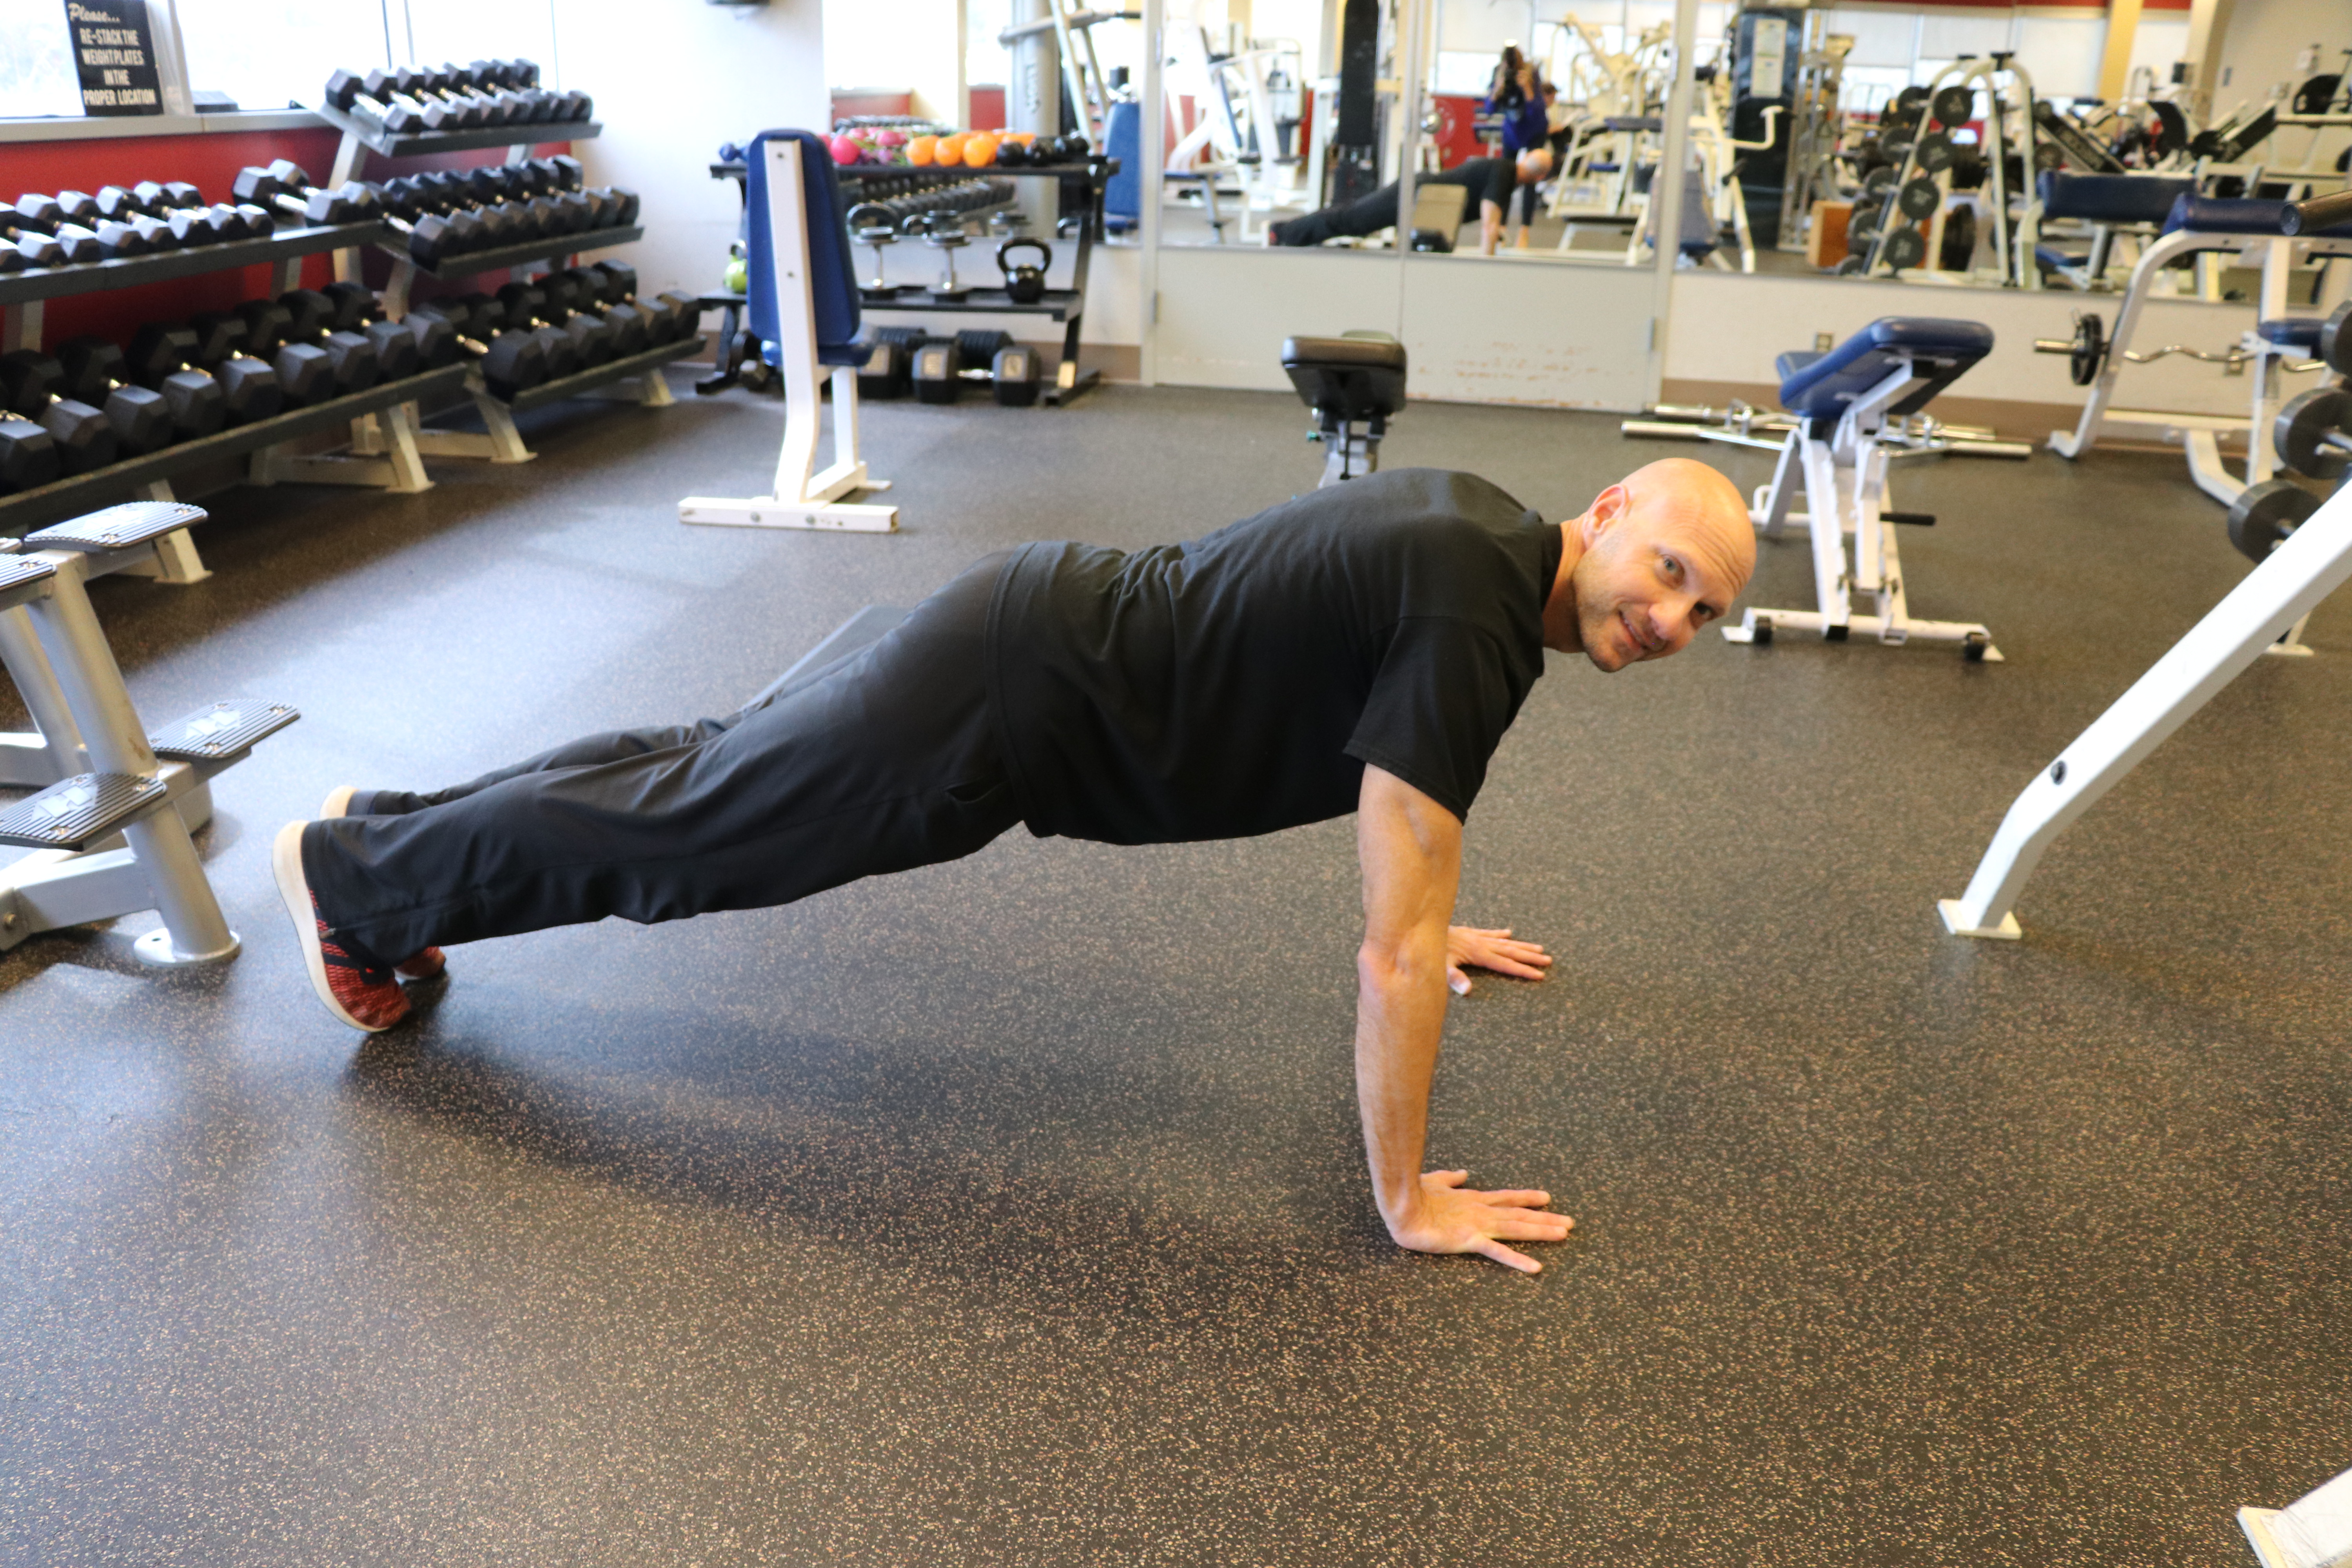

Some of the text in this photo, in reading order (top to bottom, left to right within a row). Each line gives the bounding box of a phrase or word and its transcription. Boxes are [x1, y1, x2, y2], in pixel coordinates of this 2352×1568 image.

[80, 28, 140, 46] RE-STACK THE
[82, 49, 145, 66] WEIGHT PLATES
[103, 69, 131, 86] IN THE
[83, 89, 156, 106] PROPER LOCATION
